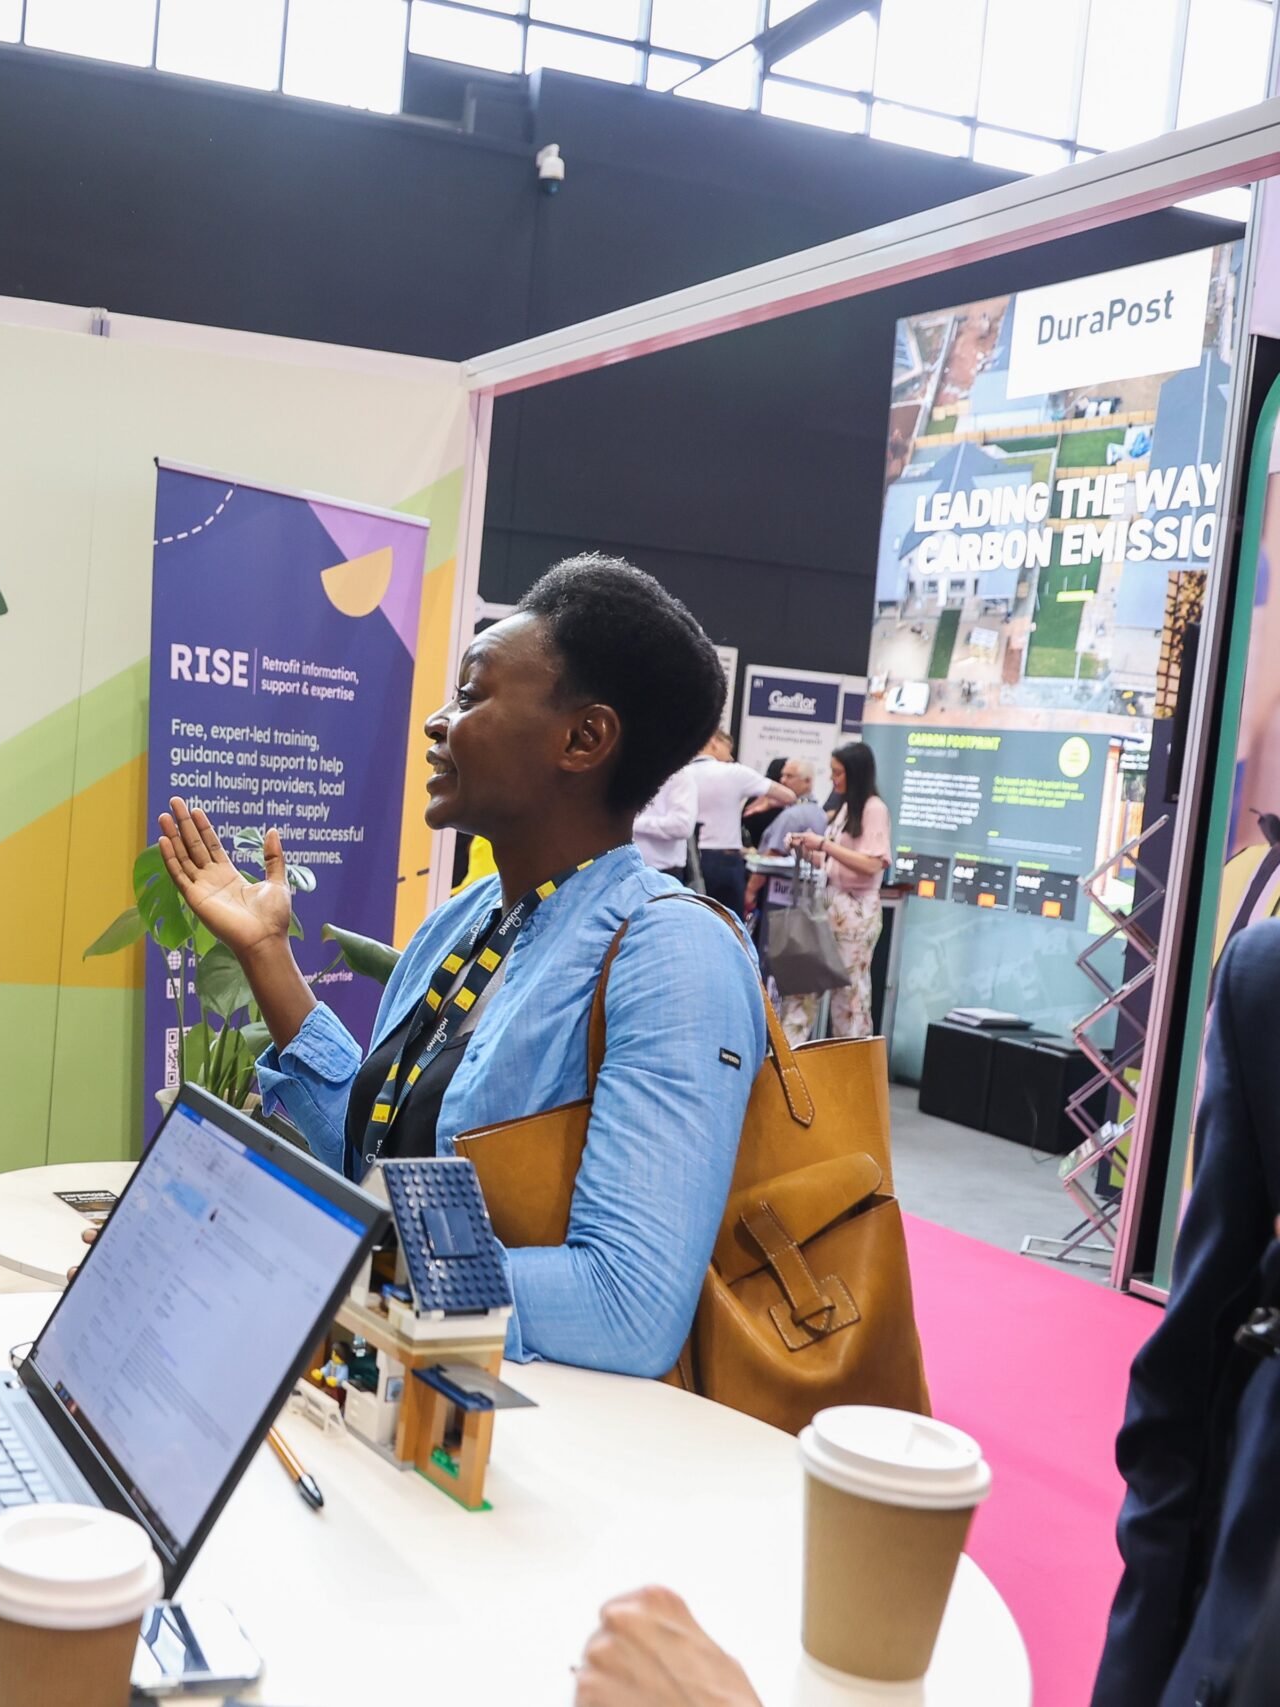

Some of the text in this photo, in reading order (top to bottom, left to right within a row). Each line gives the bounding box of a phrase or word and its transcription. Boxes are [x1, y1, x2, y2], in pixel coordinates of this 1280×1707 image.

[1037, 290, 1174, 345] DuraPost
[914, 461, 1222, 533] LEADING THE WAY
[919, 512, 1218, 575] CARBON EMISSIO
[170, 643, 360, 688] RISE Retrofit information,
[261, 678, 355, 702] support & expertise
[171, 718, 320, 752] Free, expert-led training,
[170, 744, 344, 776] guidance and support to help
[170, 769, 346, 797] social housing providers, local
[175, 796, 330, 822] uthorities and their supply
[308, 824, 364, 843] successful
[282, 851, 343, 867] ogrammes.
[498, 902, 525, 936] HOUSING
